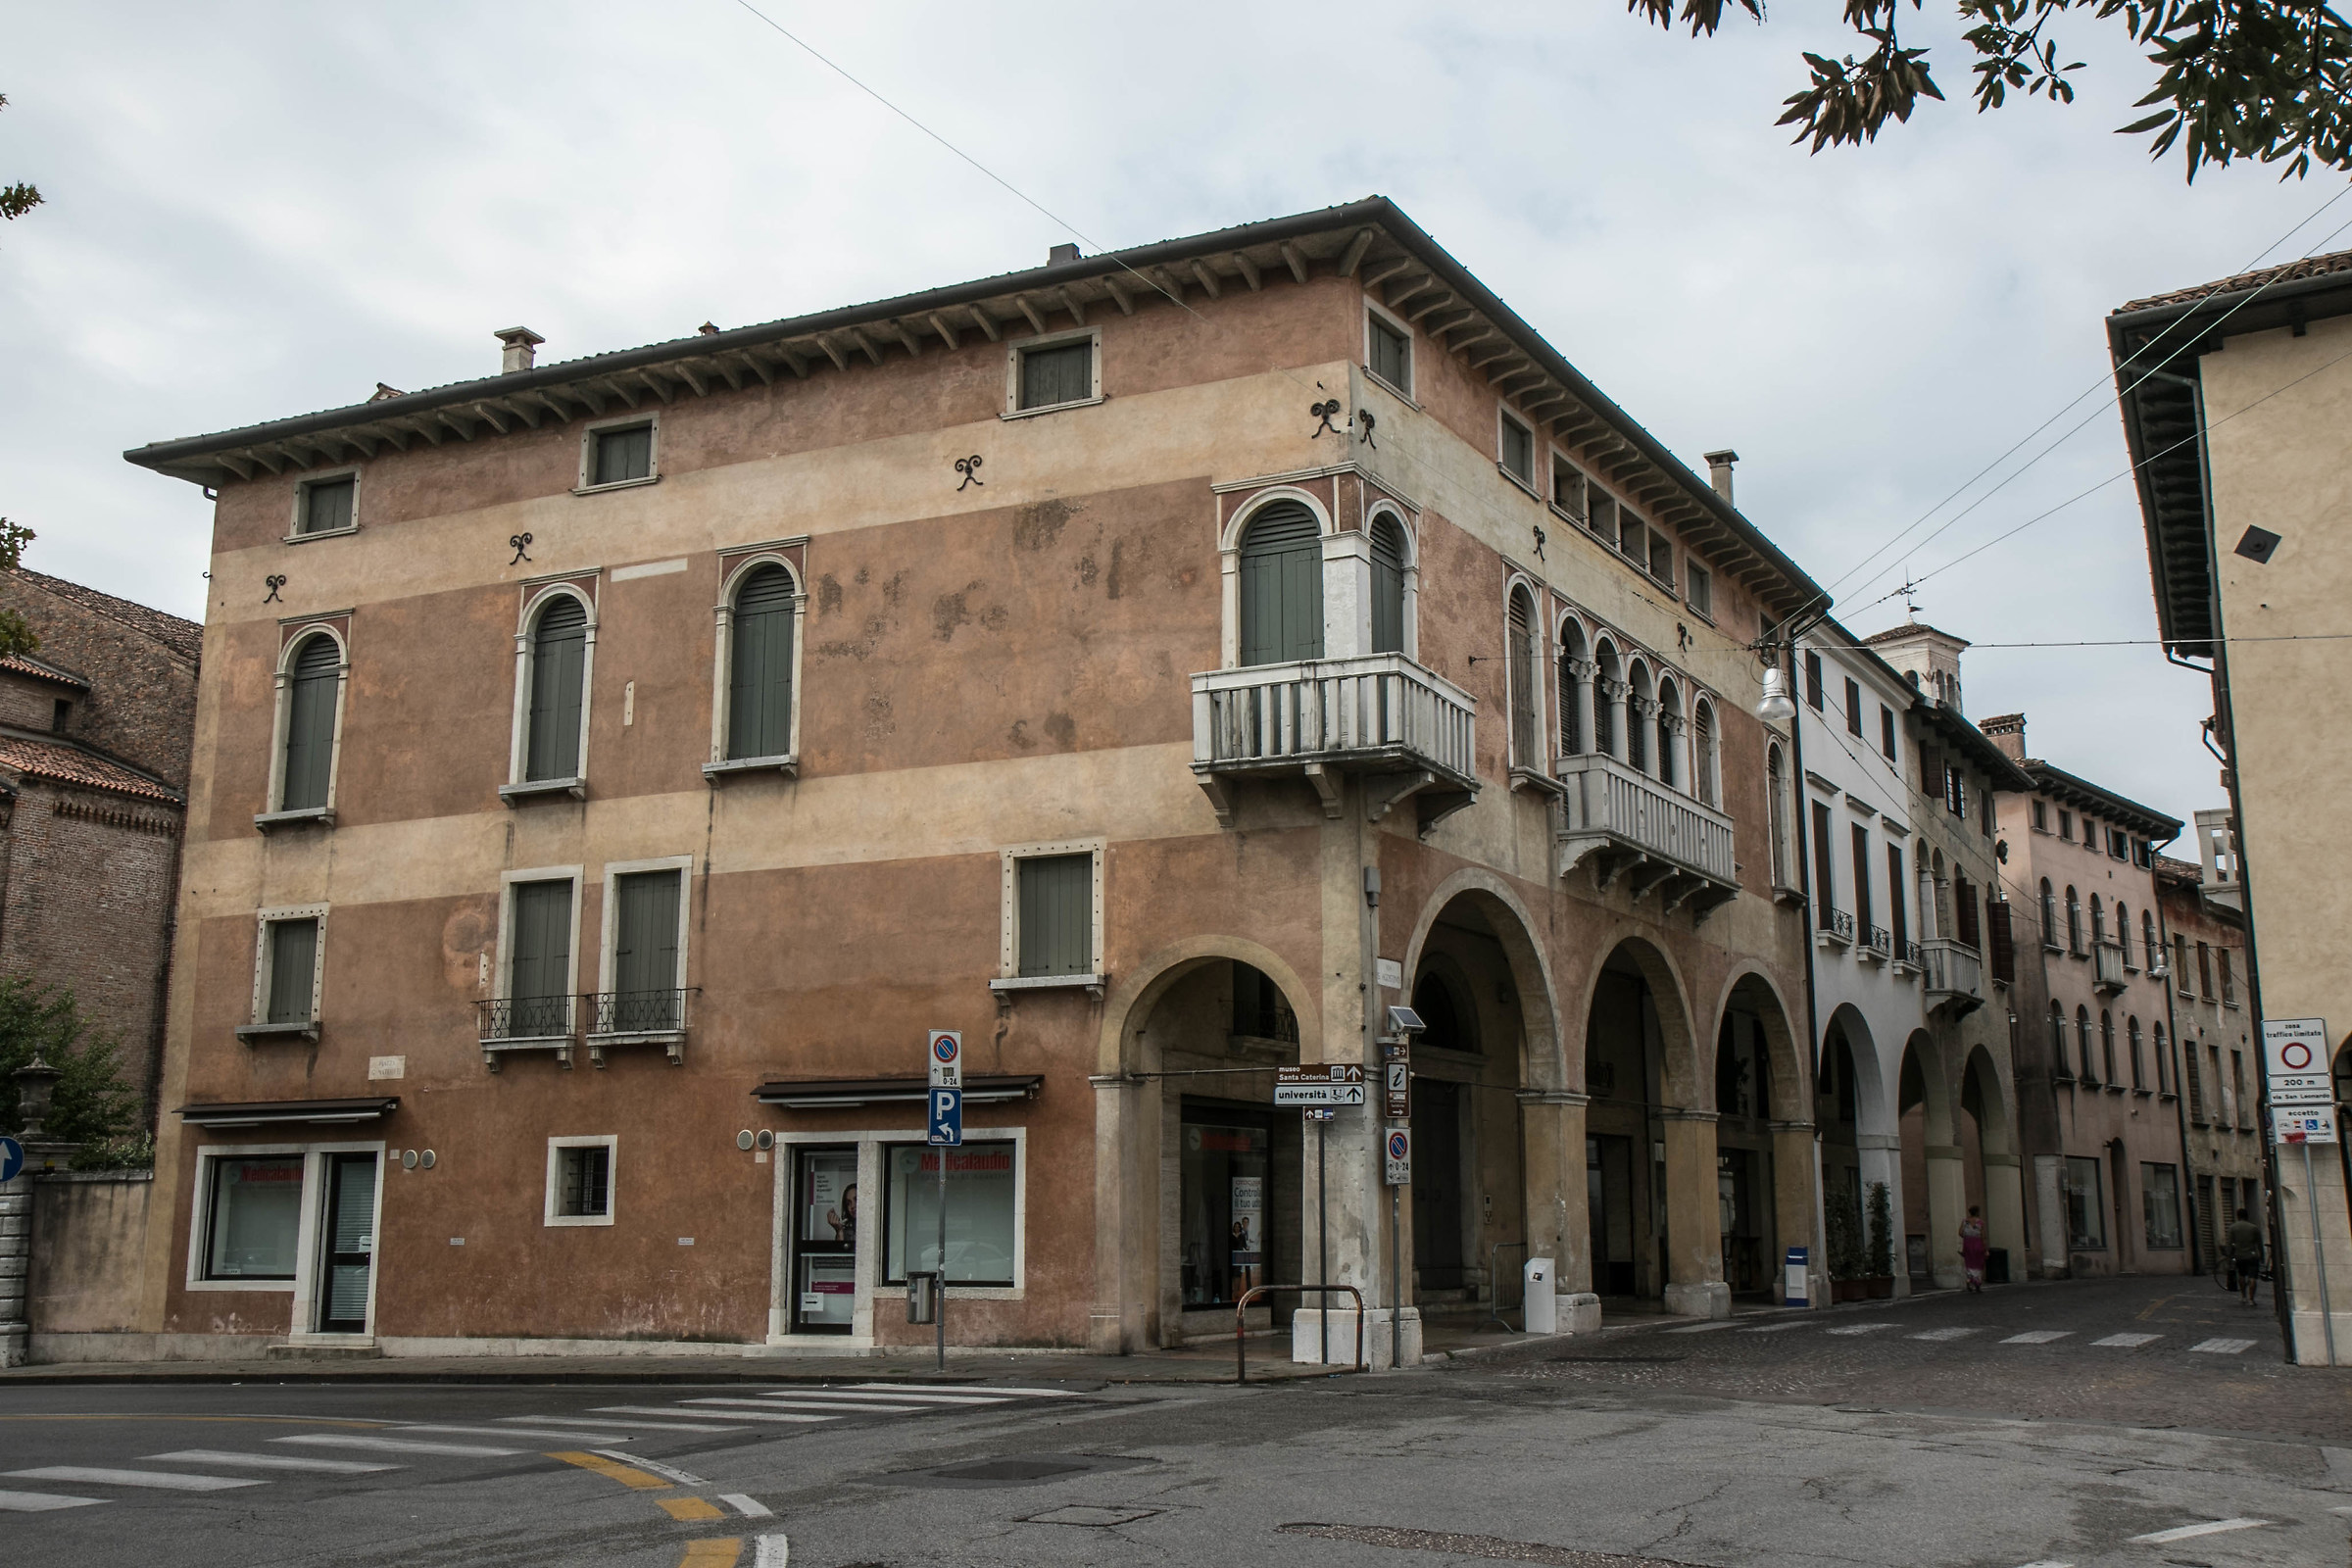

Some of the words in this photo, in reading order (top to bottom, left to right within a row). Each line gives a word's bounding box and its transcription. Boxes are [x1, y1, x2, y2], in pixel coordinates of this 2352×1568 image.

[1279, 1090, 1327, 1100] università
[936, 1092, 956, 1120] P
[241, 1164, 305, 1182] Medicalaudi
[1395, 1162, 1409, 1171] 0-24
